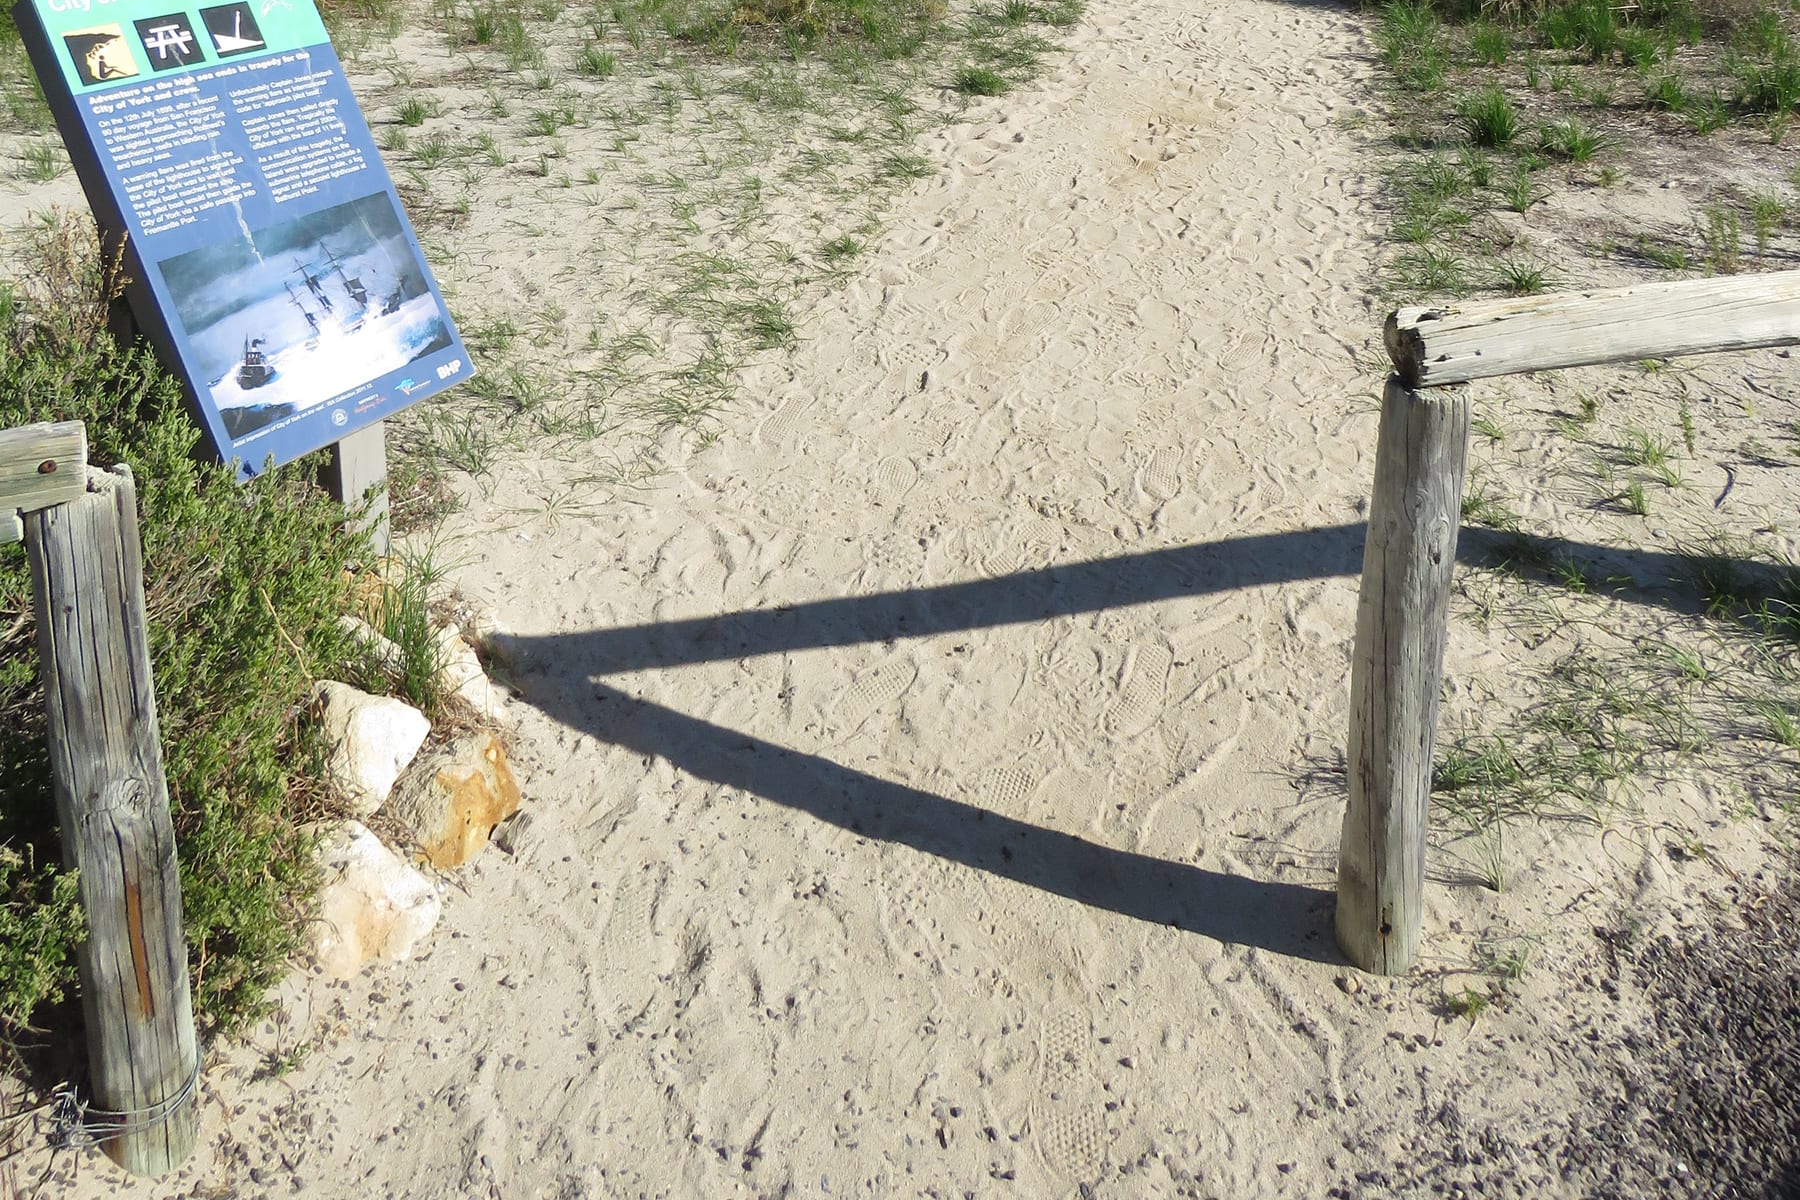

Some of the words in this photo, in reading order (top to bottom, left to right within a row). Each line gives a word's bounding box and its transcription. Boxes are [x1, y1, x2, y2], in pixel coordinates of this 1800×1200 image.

[89, 89, 140, 104] Adventure
[156, 82, 173, 90] the
[174, 76, 195, 86] high
[197, 73, 214, 81] sea
[215, 68, 237, 77] ends
[248, 58, 281, 70] tragedy
[295, 52, 310, 60] the
[92, 105, 113, 114] City
[116, 100, 126, 109] of
[128, 95, 152, 106] York
[154, 91, 172, 101] and
[173, 87, 200, 96] crew.
[436, 360, 462, 379] BHP
